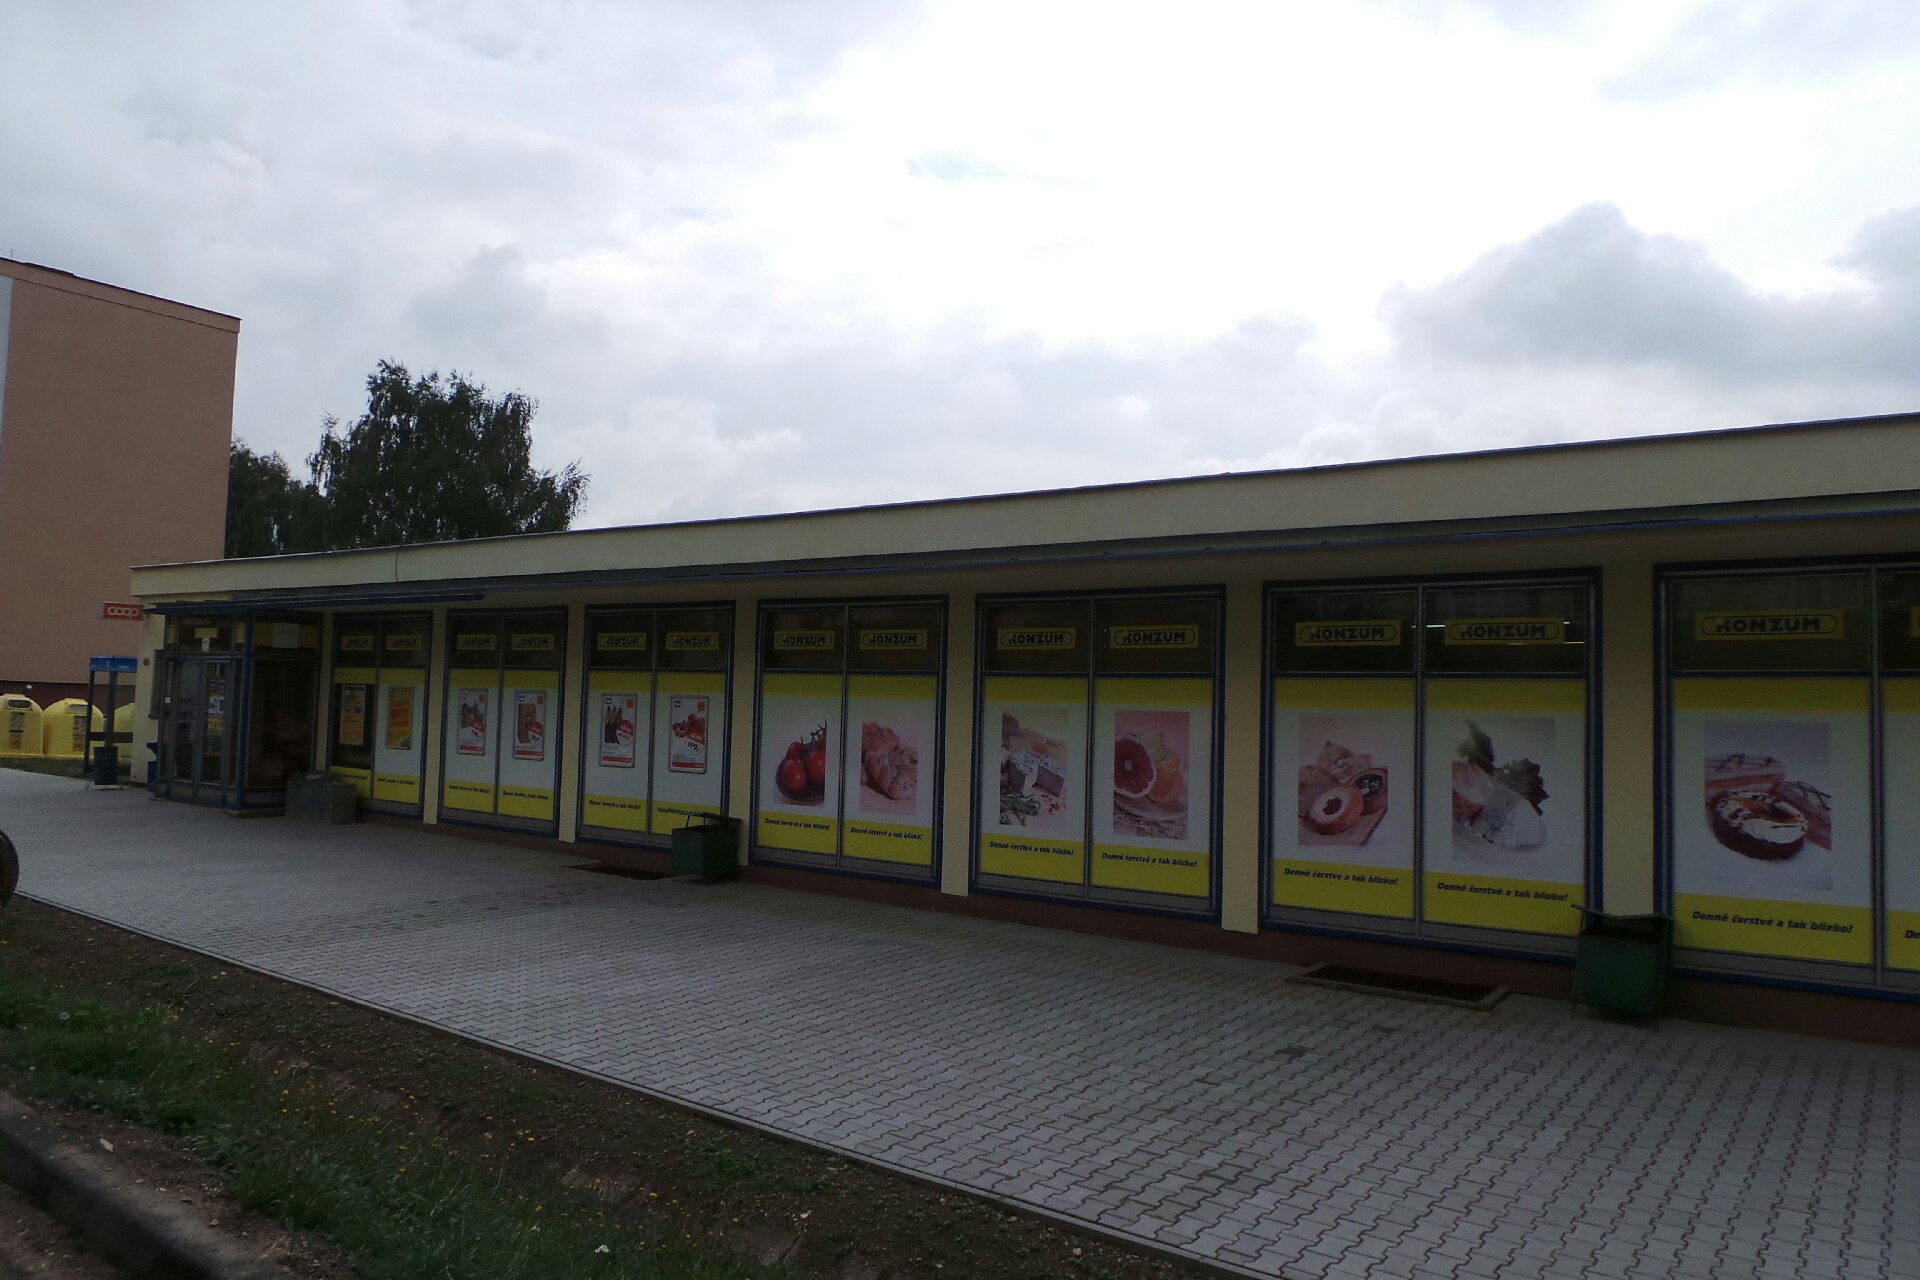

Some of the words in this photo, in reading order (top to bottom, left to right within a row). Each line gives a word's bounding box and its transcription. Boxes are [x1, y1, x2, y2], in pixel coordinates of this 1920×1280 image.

[1460, 623, 1546, 639] KONZUM
[1715, 616, 1821, 633] KONZUM
[782, 635, 826, 645] KONZUM
[869, 634, 917, 645] KONZUM
[1007, 632, 1064, 645] KONZUM
[1122, 630, 1186, 643] KONZUM
[1309, 627, 1385, 641] KONZUM
[1776, 918, 1784, 927] a
[1788, 920, 1807, 929] tak
